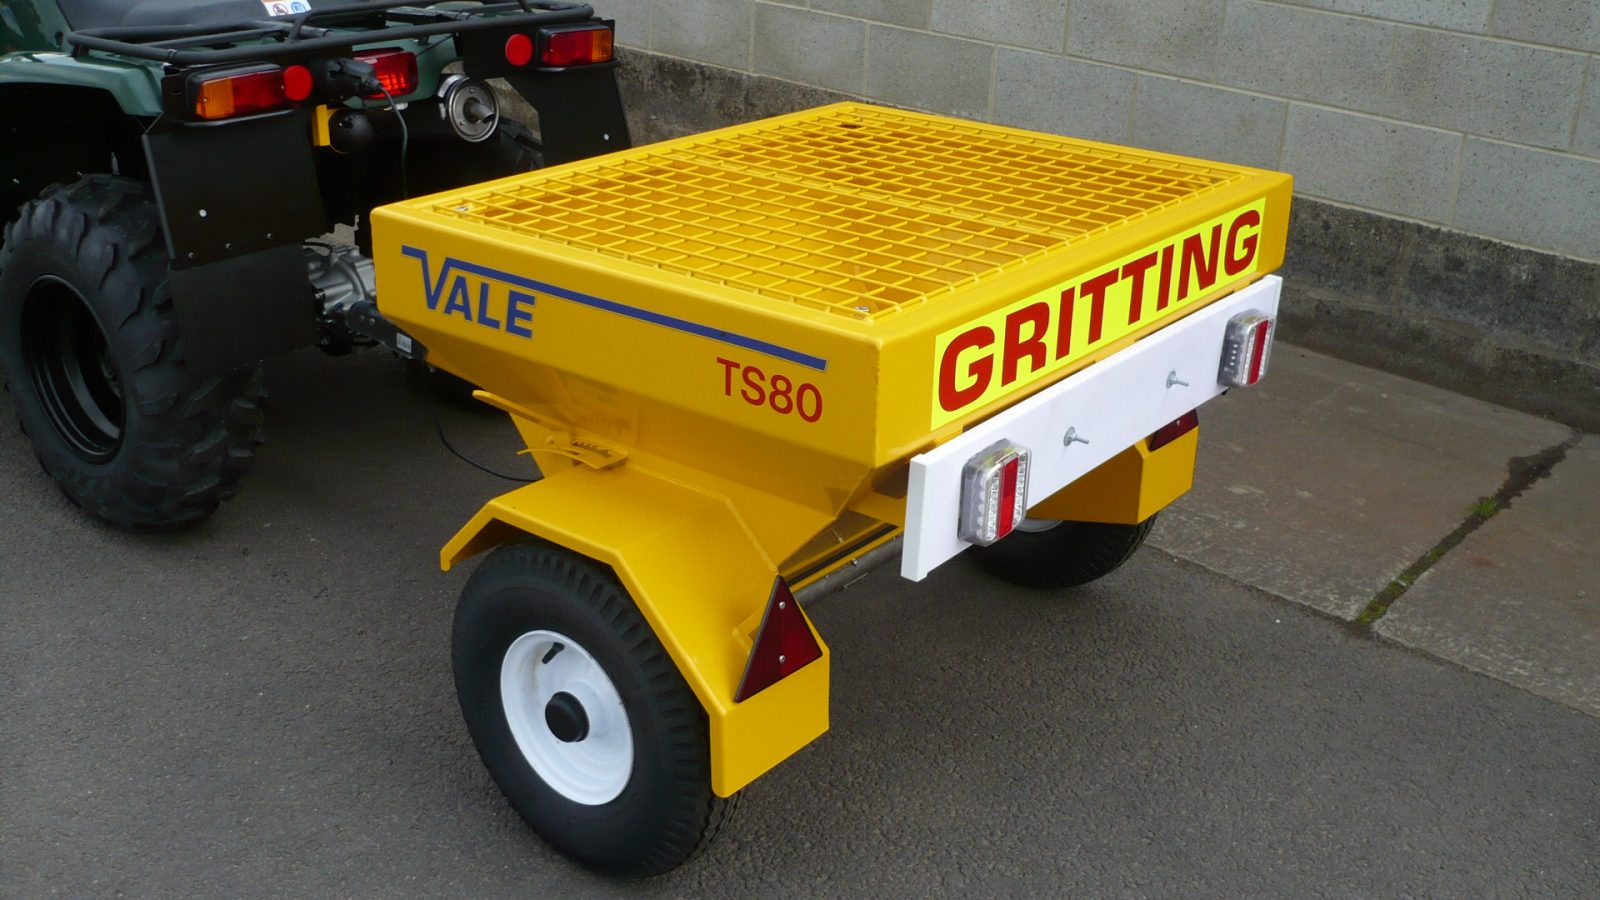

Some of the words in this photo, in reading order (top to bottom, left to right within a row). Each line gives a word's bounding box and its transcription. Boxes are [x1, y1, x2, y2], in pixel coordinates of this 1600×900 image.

[402, 244, 536, 339] VALE
[938, 209, 1260, 412] GRITTING
[716, 356, 823, 423] TS80
